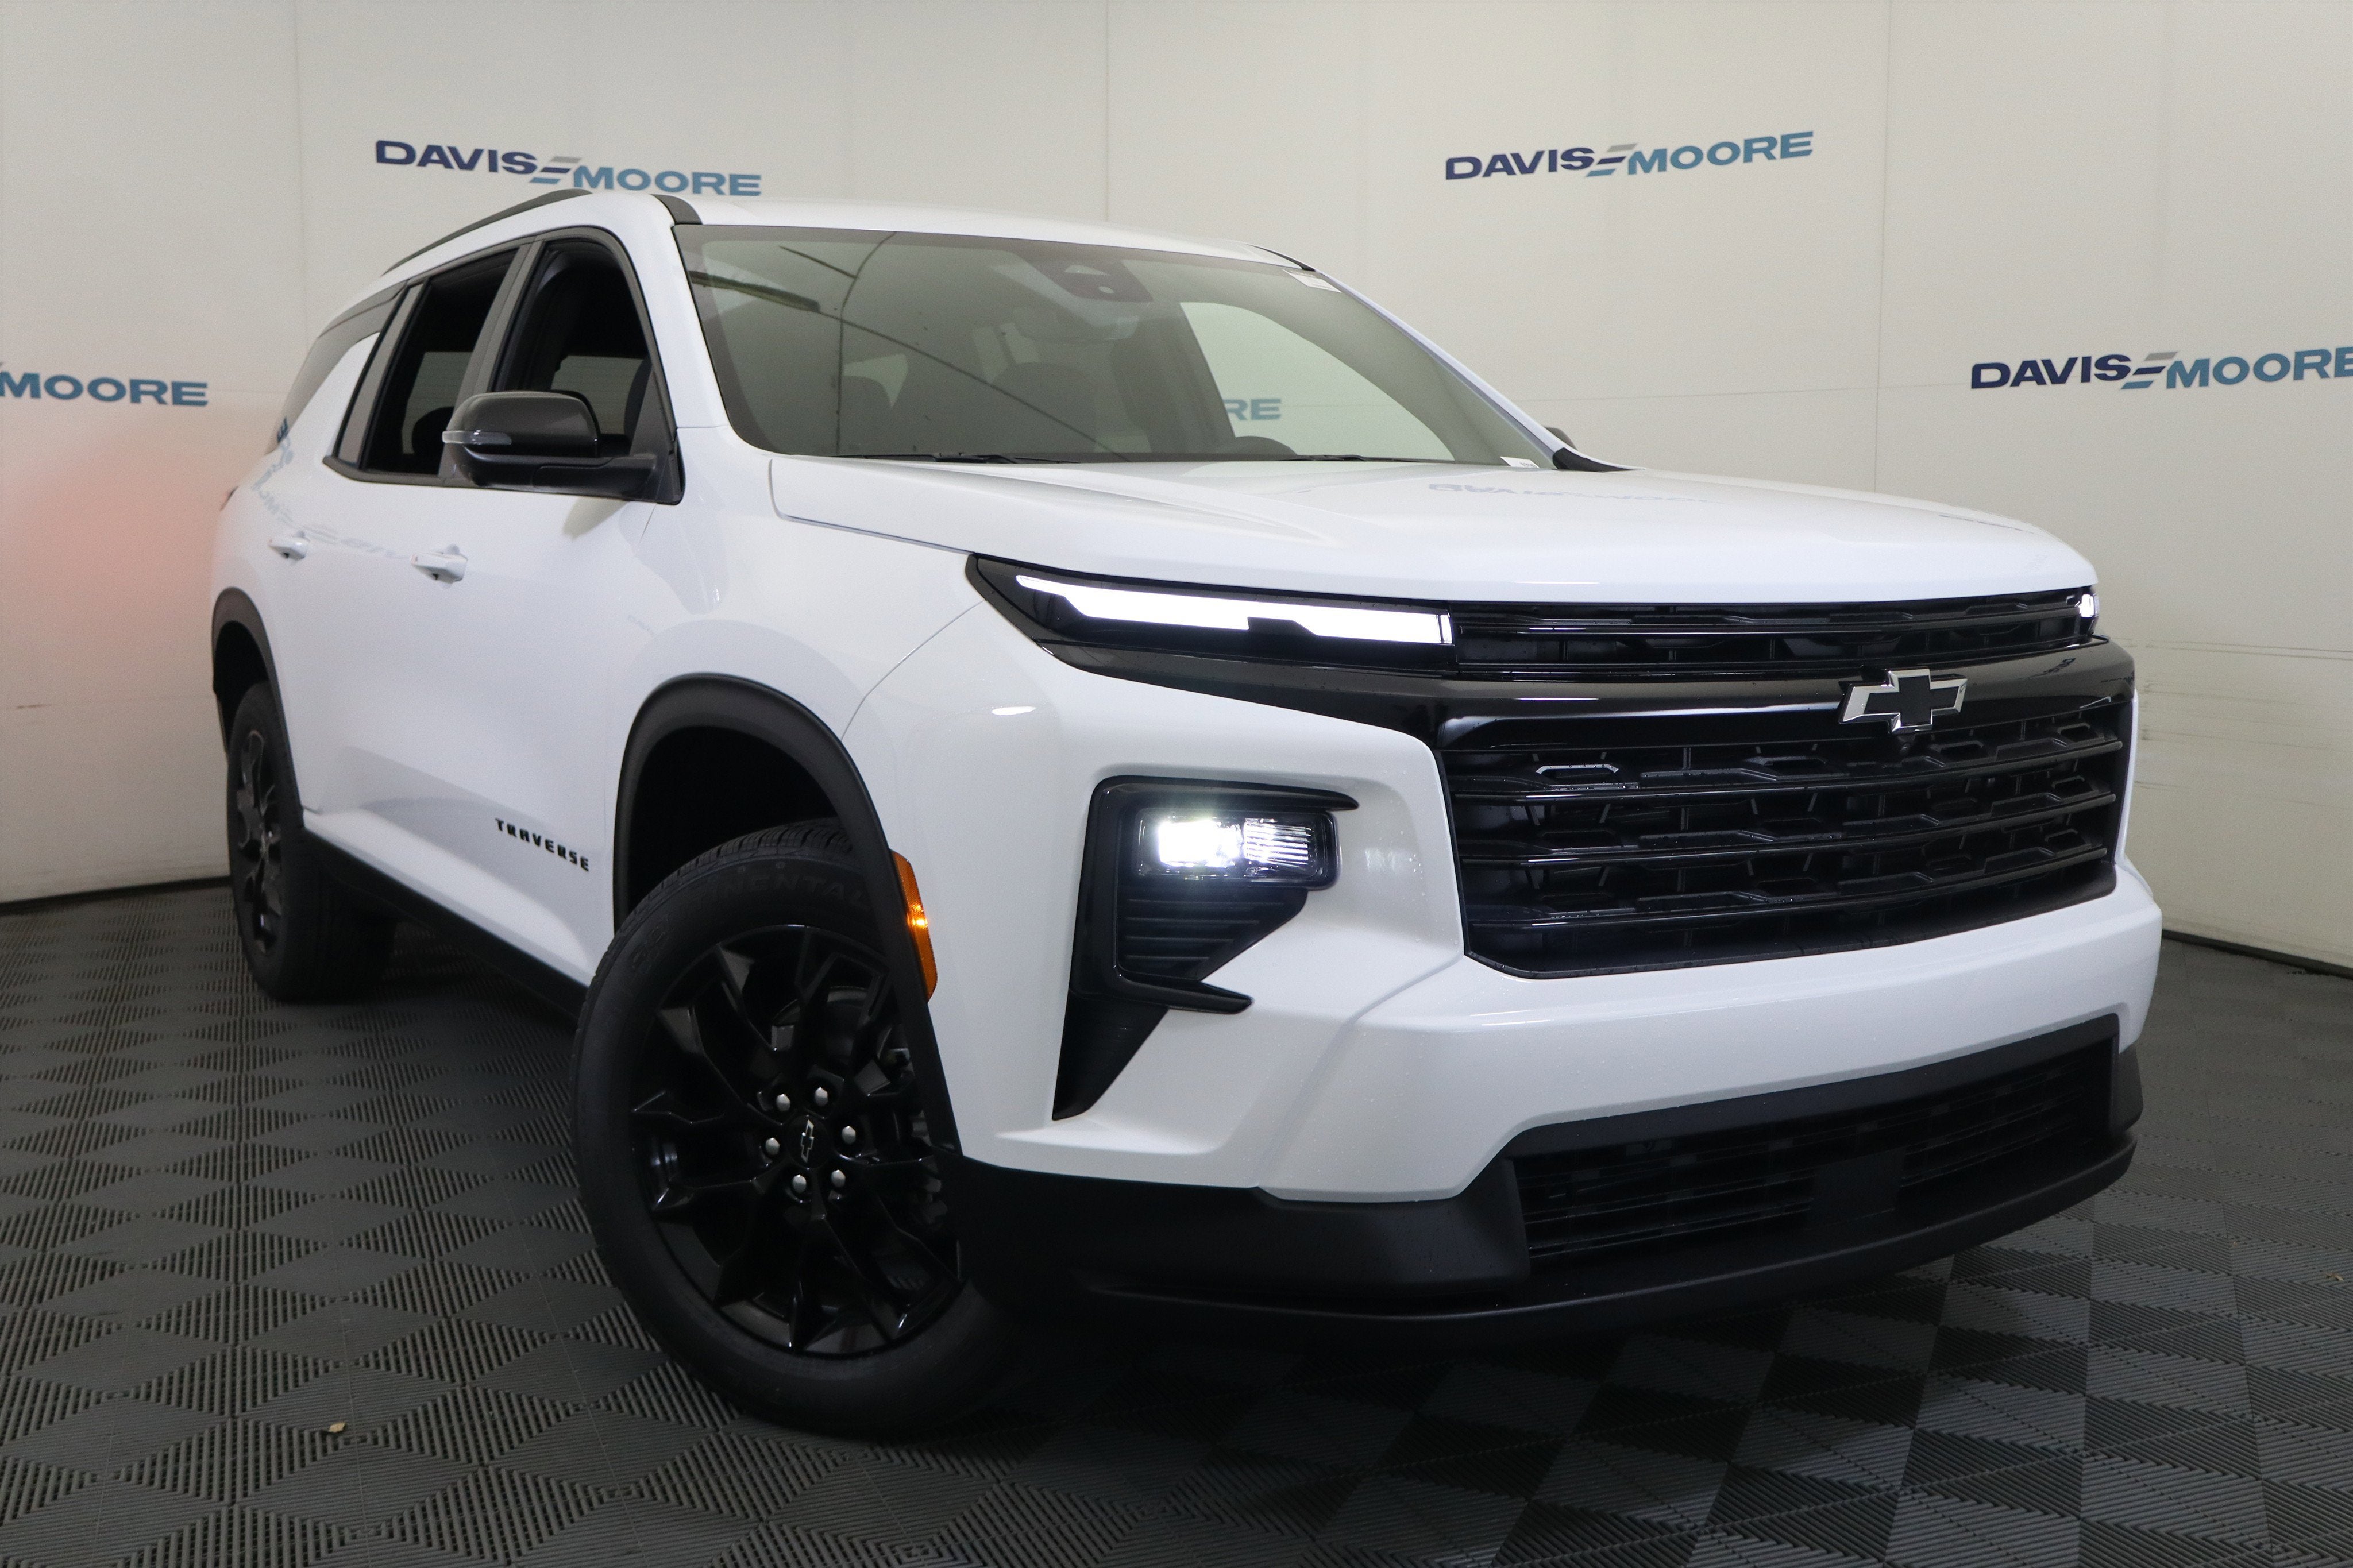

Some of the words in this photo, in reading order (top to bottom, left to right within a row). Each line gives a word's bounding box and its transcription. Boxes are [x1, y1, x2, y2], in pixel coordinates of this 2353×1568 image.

[376, 140, 538, 175] DAVIS
[573, 165, 762, 196] MOORE
[1445, 147, 1595, 180] DAVIS
[1627, 131, 1814, 175] MOORE
[0, 371, 208, 407] MOORE
[1971, 354, 2131, 389] DAVIS
[2166, 346, 2353, 389] MOORE
[1222, 399, 1281, 420] RE
[495, 818, 589, 872] TRAVERSE
